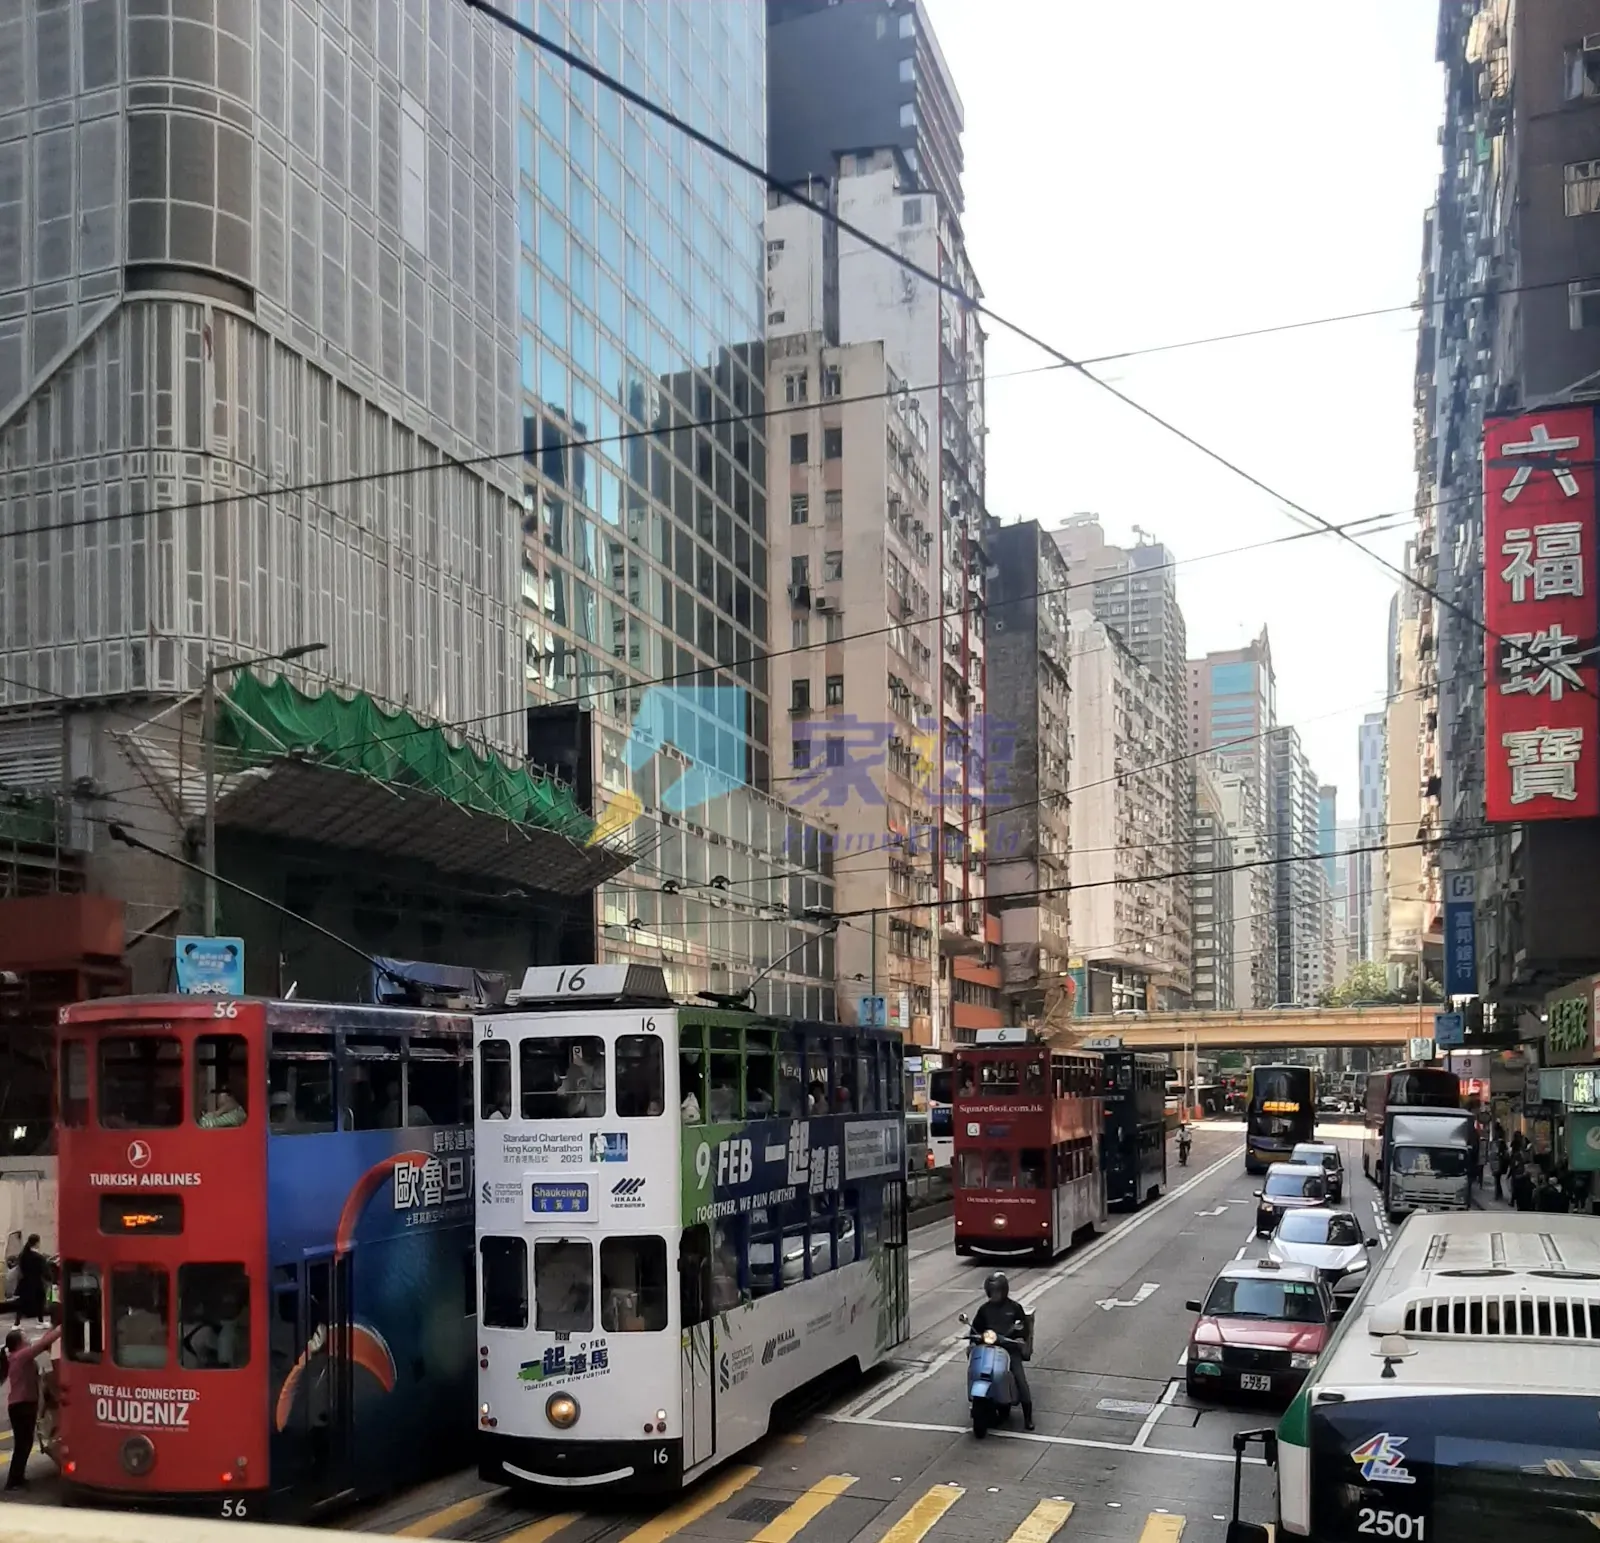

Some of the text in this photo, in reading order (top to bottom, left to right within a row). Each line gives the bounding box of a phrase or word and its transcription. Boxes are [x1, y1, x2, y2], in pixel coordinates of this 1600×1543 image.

[1501, 424, 1585, 805] 六福珠寶
[556, 967, 587, 993] 16
[213, 1001, 238, 1018] 56
[483, 1024, 494, 1038] 16
[642, 1016, 656, 1032] 16
[997, 1030, 1007, 1041] 6
[959, 1104, 1044, 1114] Squarefoot.com.hk
[503, 1133, 583, 1143] Standard Chartered
[503, 1145, 583, 1154] Hong Kong Marathon
[560, 1155, 583, 1164] 2025
[695, 1138, 753, 1190] 9 FEB
[89, 1173, 202, 1186] TURKISH AIRLINES
[534, 1186, 587, 1198] Shaukeiwan
[697, 1201, 737, 1222] TOGETHER,
[739, 1199, 751, 1211] WE
[752, 1193, 768, 1206] RUN
[769, 1186, 796, 1204] FURTHER
[580, 1338, 607, 1351] 9 FEB
[524, 1381, 554, 1391] TOGETHER,
[567, 1374, 581, 1383] RUN
[582, 1368, 611, 1380] FURTHER
[89, 1383, 200, 1401] WE'RE ALL CONNECTED:
[96, 1398, 190, 1425] OLUDENIZ
[653, 1448, 669, 1464] 16
[221, 1498, 247, 1517] 56
[1357, 1507, 1425, 1541] 2501
